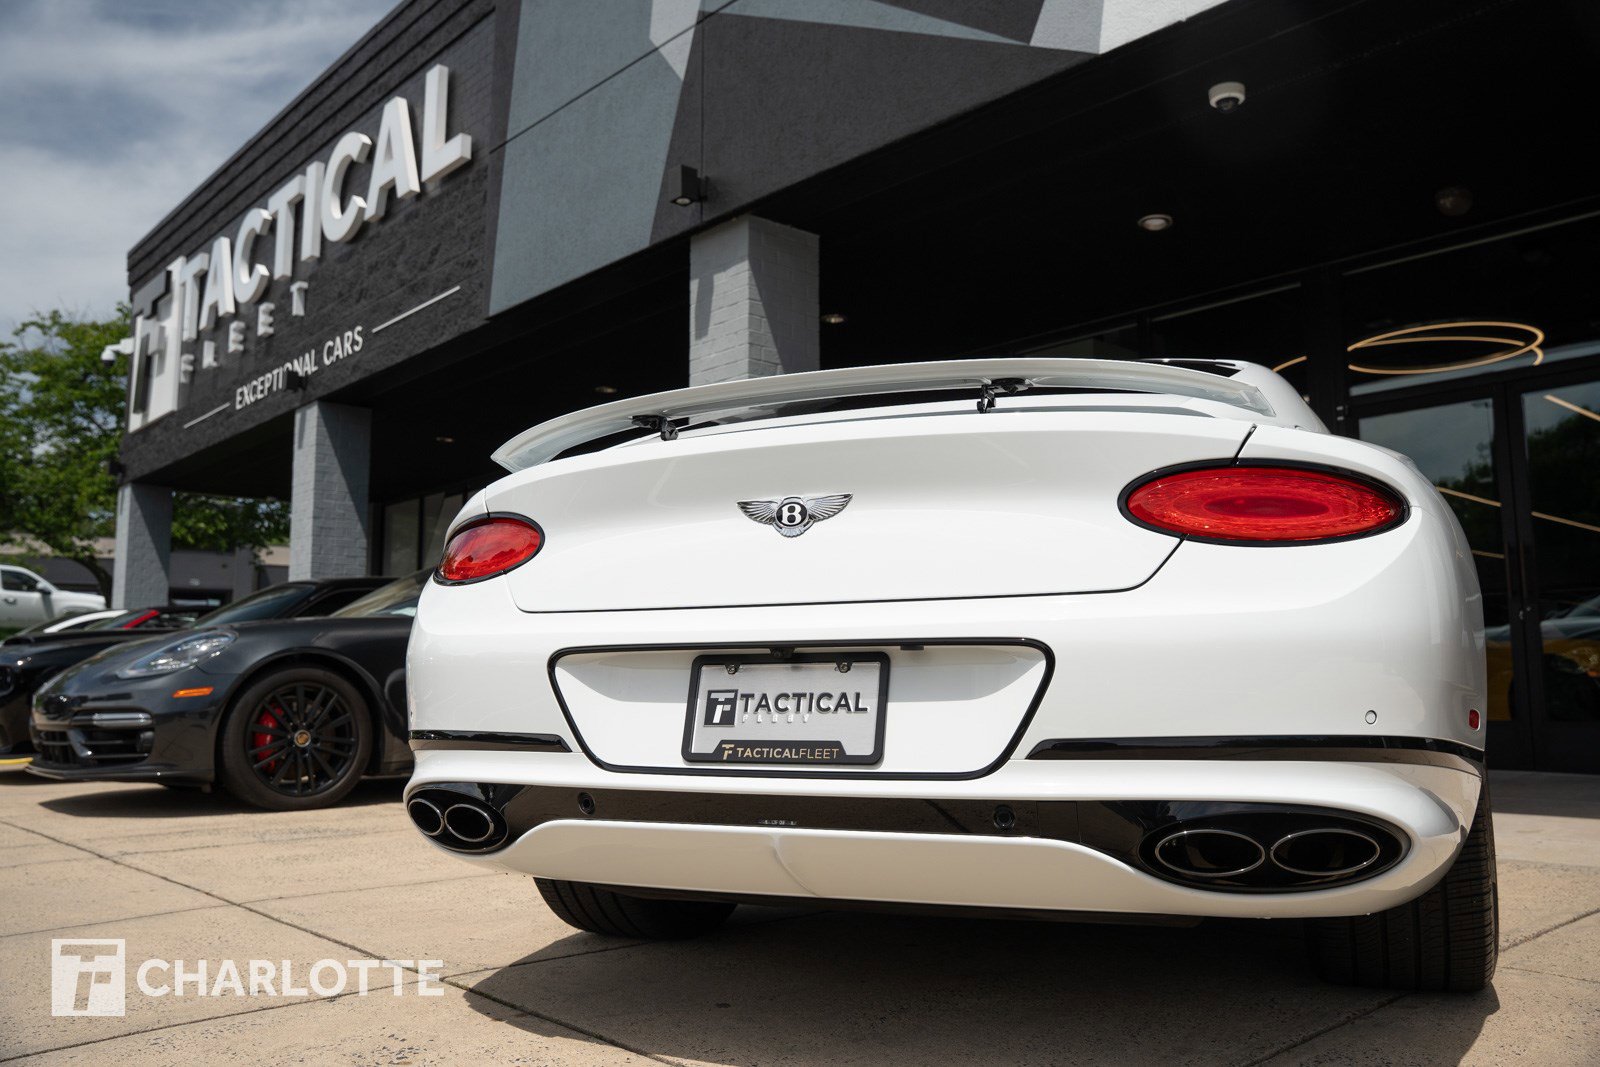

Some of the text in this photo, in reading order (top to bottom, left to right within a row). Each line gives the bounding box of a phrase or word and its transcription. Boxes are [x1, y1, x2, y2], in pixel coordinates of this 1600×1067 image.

[179, 63, 472, 343] TACTICAL
[180, 281, 308, 384] FLEET
[323, 325, 363, 366] CARS
[782, 504, 802, 525] B
[740, 692, 868, 714] TACTICAL
[736, 747, 840, 759] TACTICALFLEET
